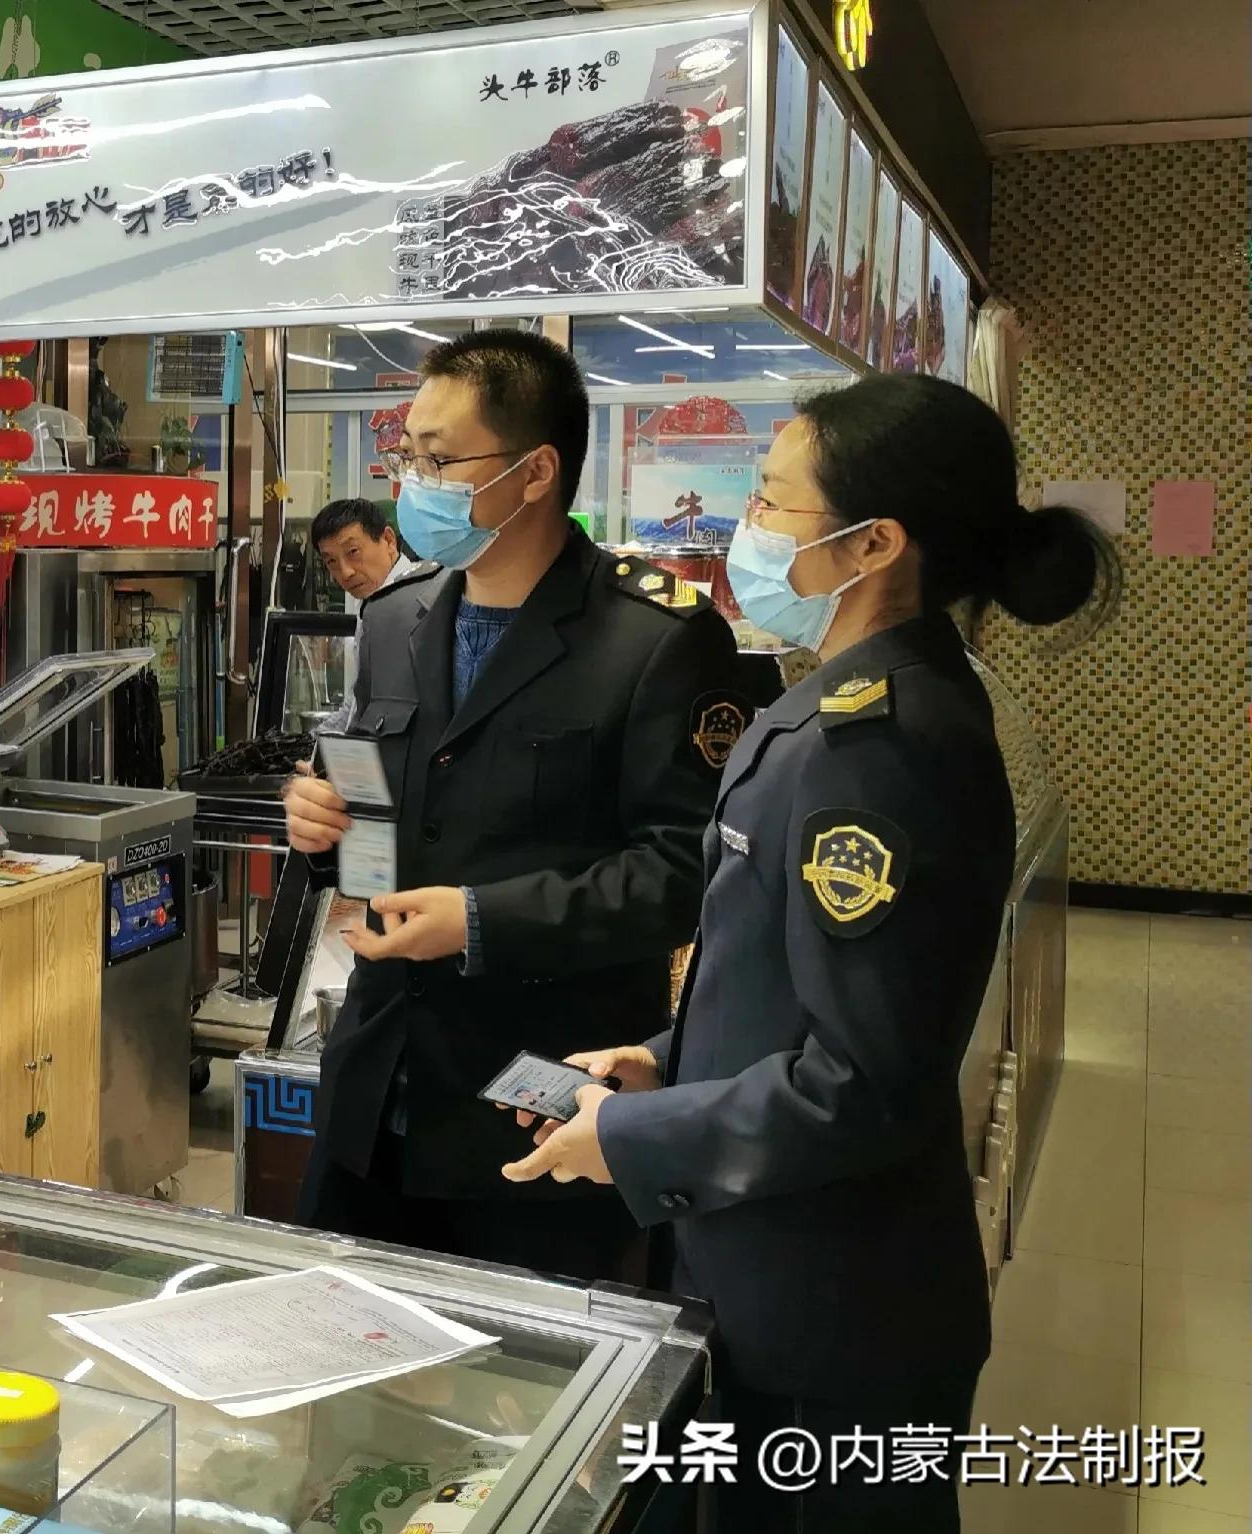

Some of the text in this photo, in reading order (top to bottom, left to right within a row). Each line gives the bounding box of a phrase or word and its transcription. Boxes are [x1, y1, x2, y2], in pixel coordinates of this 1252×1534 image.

[480, 62, 606, 102] 头牛部落
[18, 489, 216, 541] 现烤牛肉干
